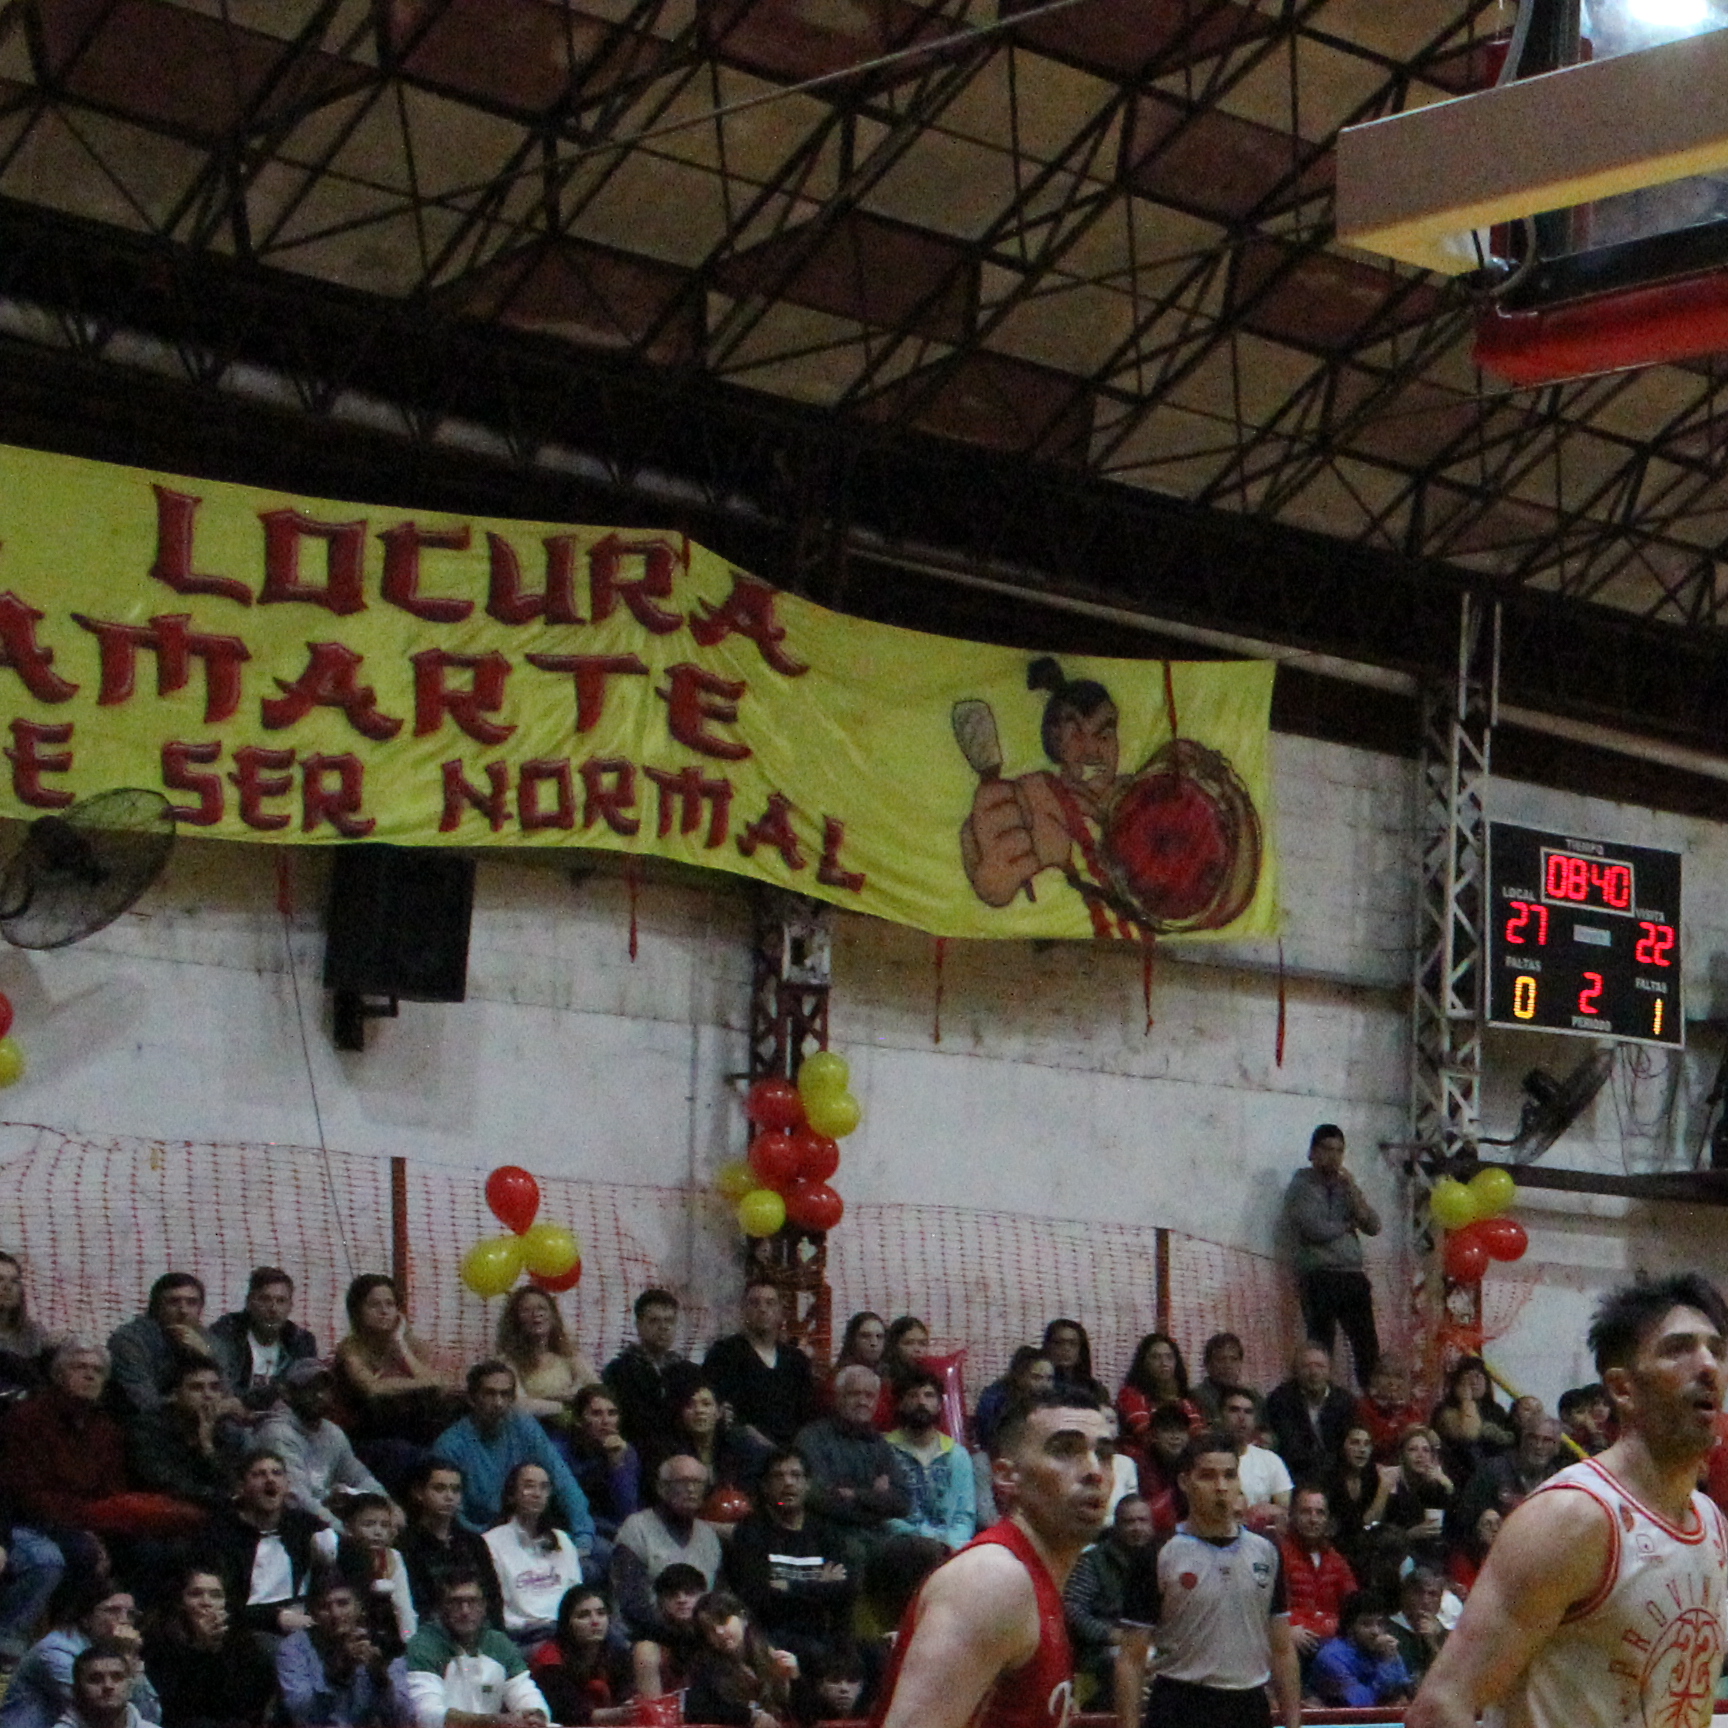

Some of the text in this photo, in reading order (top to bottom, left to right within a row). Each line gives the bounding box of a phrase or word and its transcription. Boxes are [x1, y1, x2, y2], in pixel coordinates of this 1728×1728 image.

[150, 482, 808, 676] LOCURA
[0, 589, 753, 760] AMARTE
[160, 740, 376, 838] SER
[439, 757, 866, 892] NORMAL
[1502, 886, 1536, 901] LOCAL
[1505, 901, 1549, 945] 27
[1635, 921, 1675, 967] 22
[1513, 975, 1537, 1020] 0
[1578, 971, 1604, 1014] 2
[1652, 998, 1664, 1036] 1
